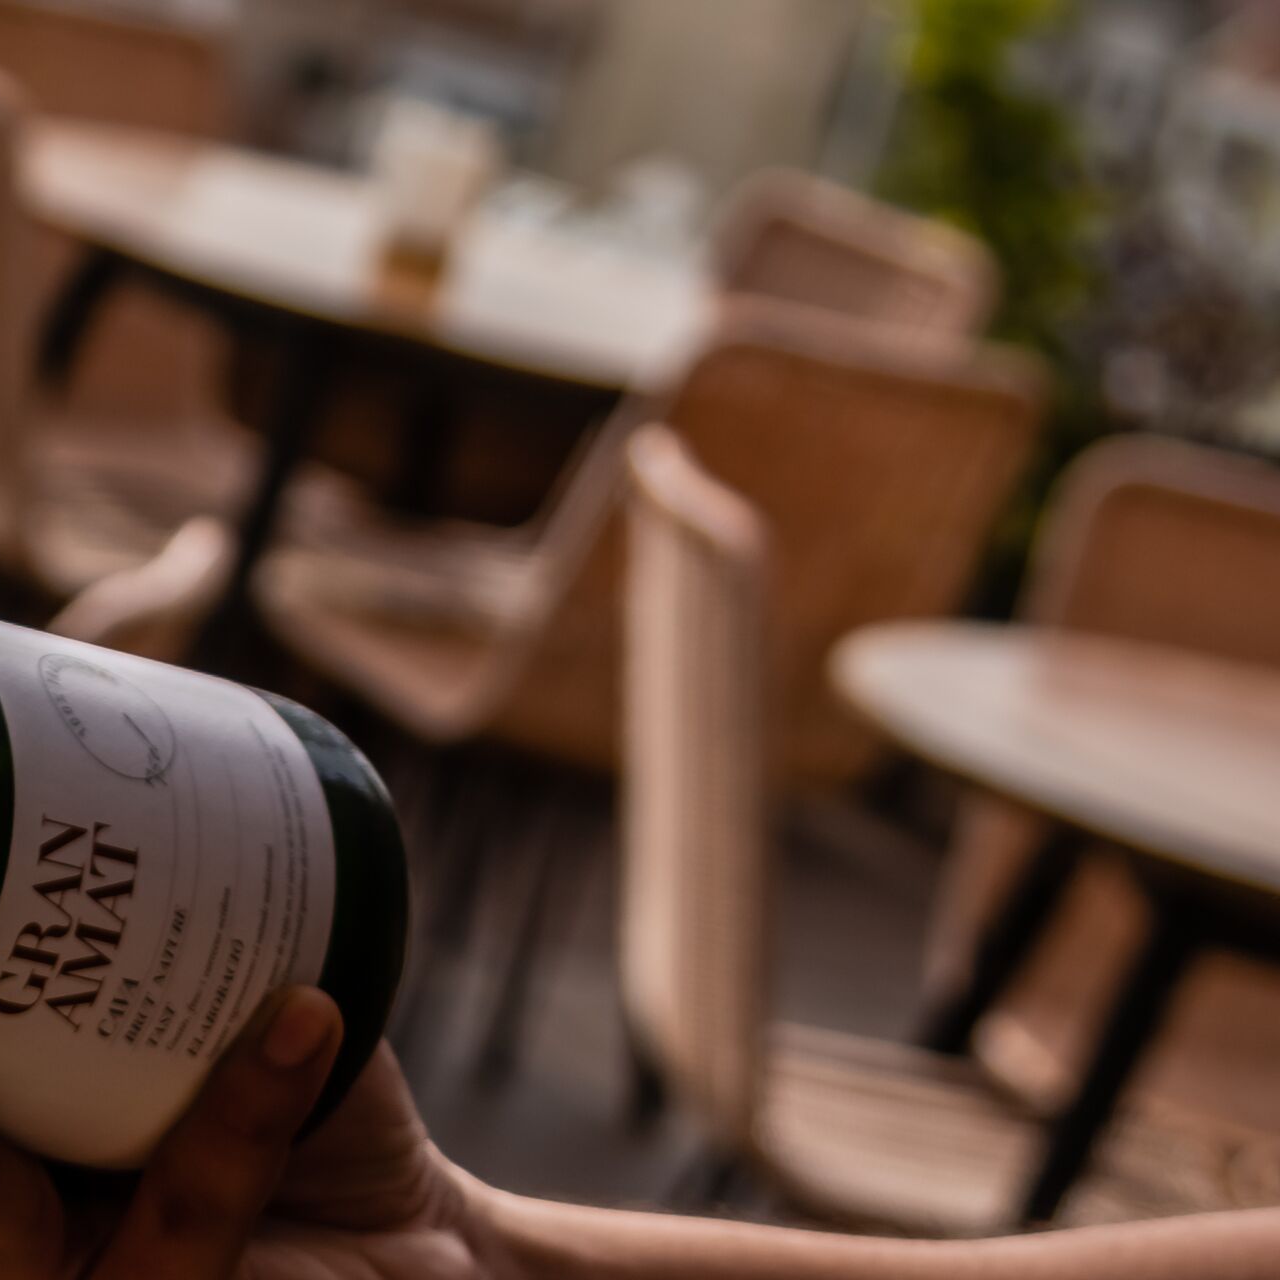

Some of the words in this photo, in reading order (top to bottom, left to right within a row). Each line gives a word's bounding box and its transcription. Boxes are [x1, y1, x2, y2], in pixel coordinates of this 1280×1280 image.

[45, 821, 139, 1033] AMAT
[124, 991, 155, 1044] BRUT
[153, 906, 188, 985] NATURE
[97, 977, 140, 1038] CAVA
